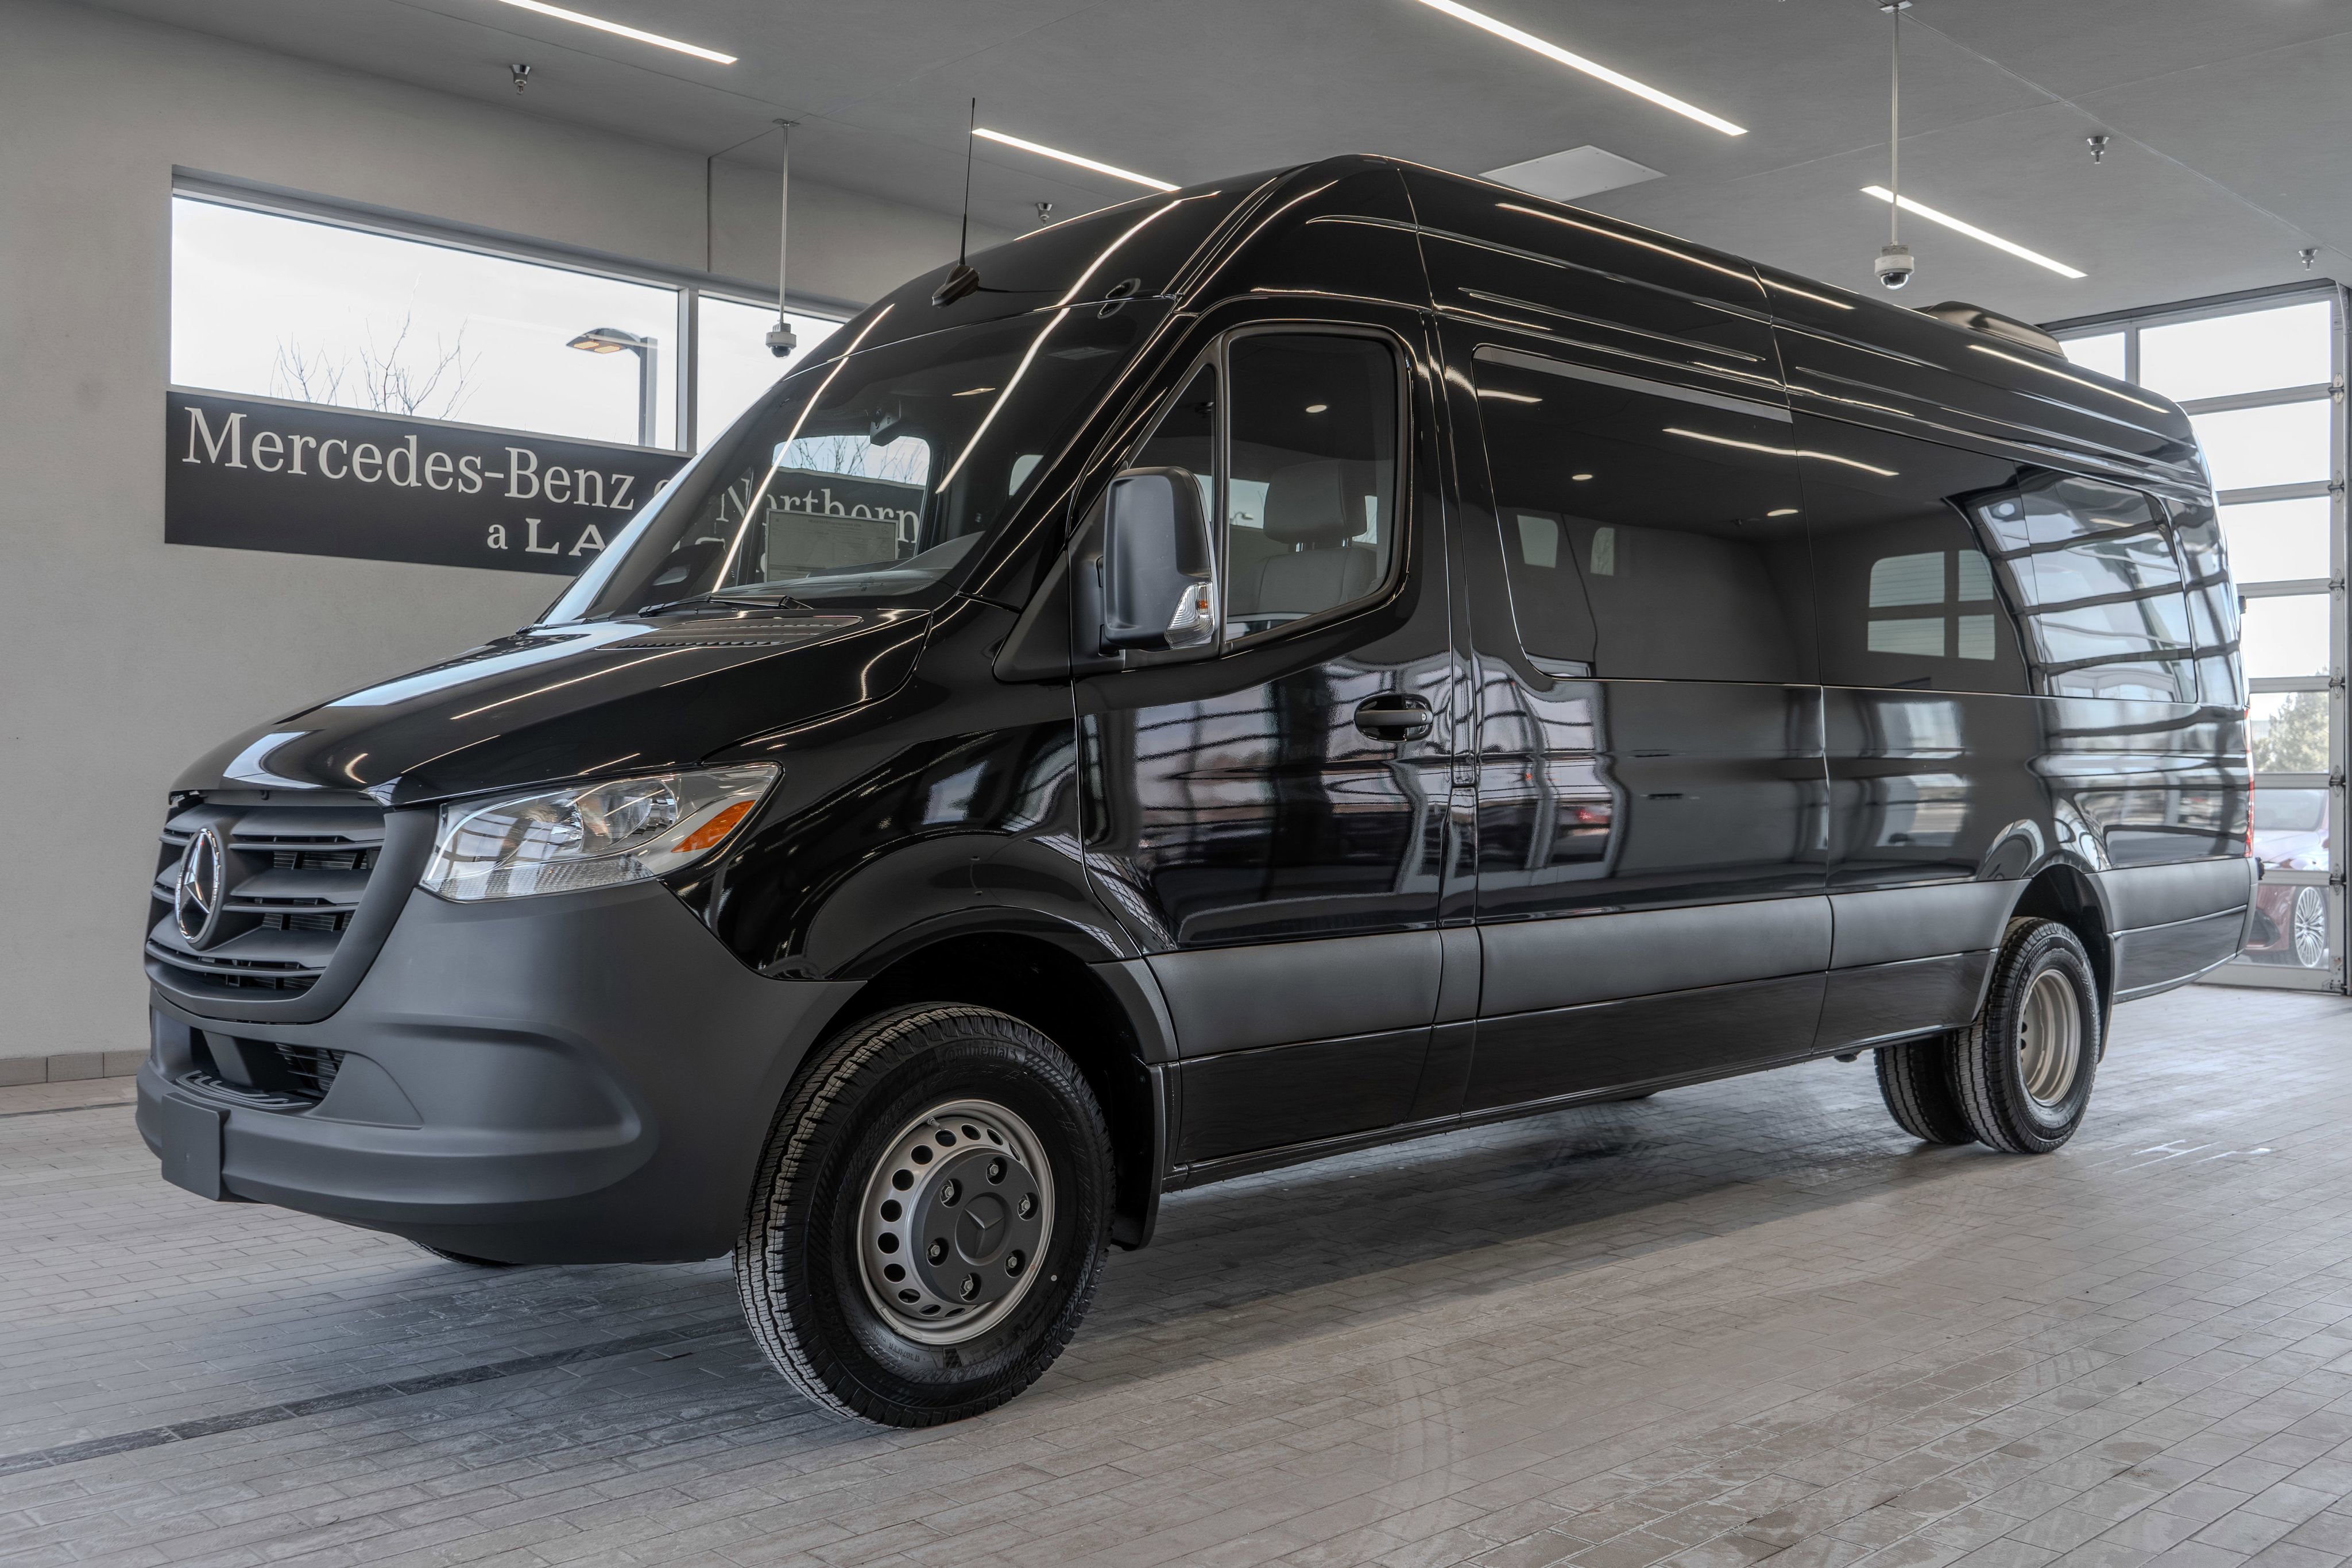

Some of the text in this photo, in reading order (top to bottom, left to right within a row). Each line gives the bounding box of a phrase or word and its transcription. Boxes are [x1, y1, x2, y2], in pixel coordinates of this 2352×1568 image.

[182, 406, 635, 510] Mercedes-Benz
[487, 524, 508, 549] a
[945, 1045, 1009, 1062] Continental
